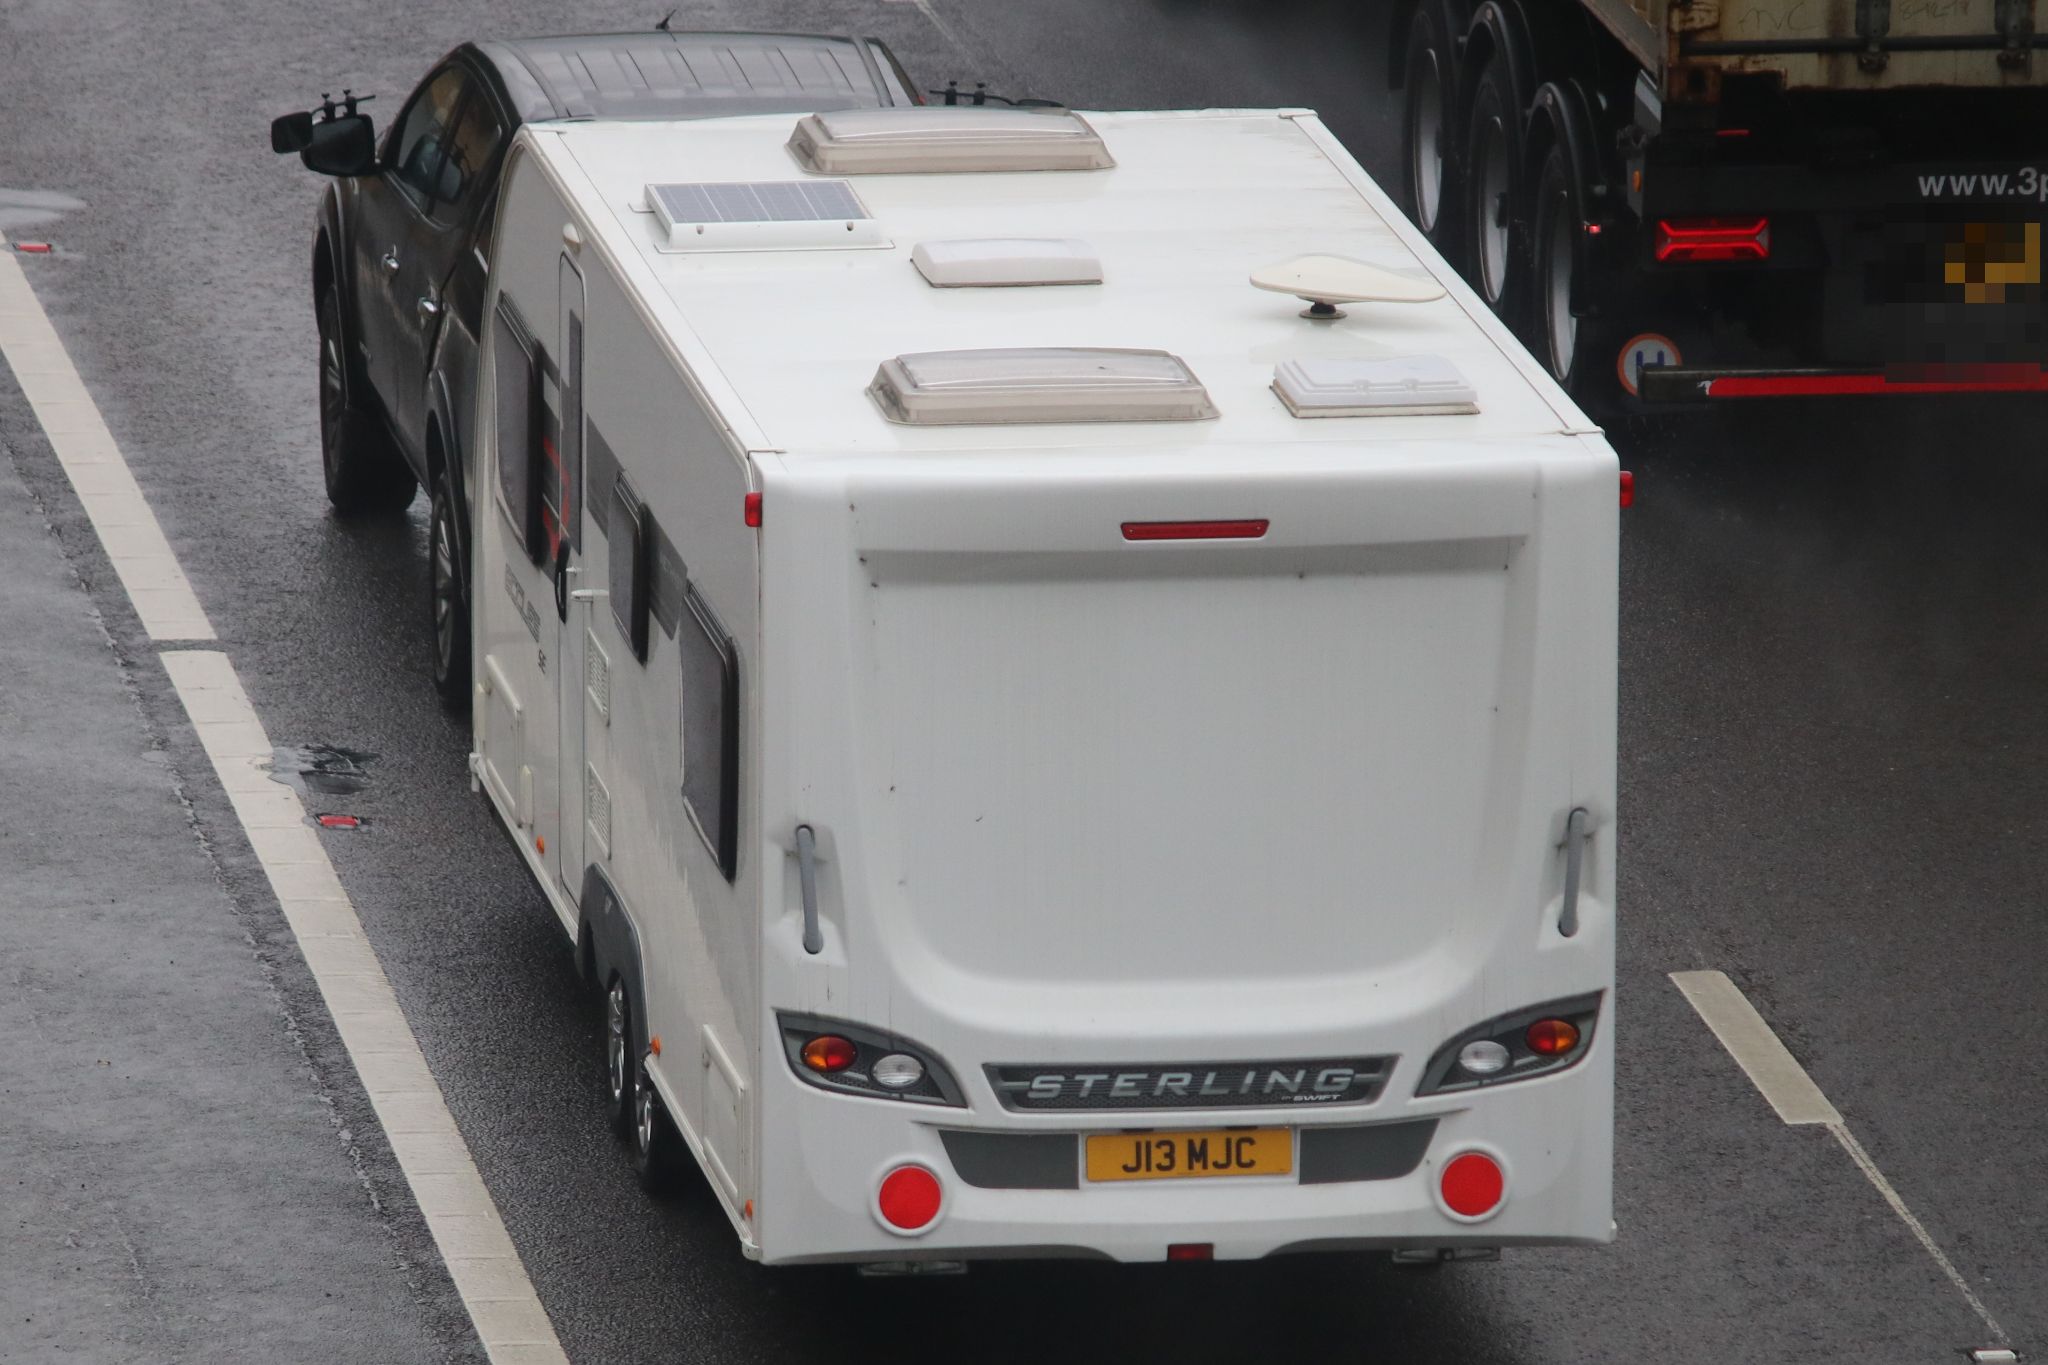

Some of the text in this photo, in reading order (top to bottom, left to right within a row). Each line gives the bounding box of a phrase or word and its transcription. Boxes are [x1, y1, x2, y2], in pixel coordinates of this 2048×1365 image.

[1028, 1068, 1354, 1099] STERLING
[1292, 1094, 1342, 1102] SWIFT
[1122, 1136, 1256, 1173] J13 MJC
